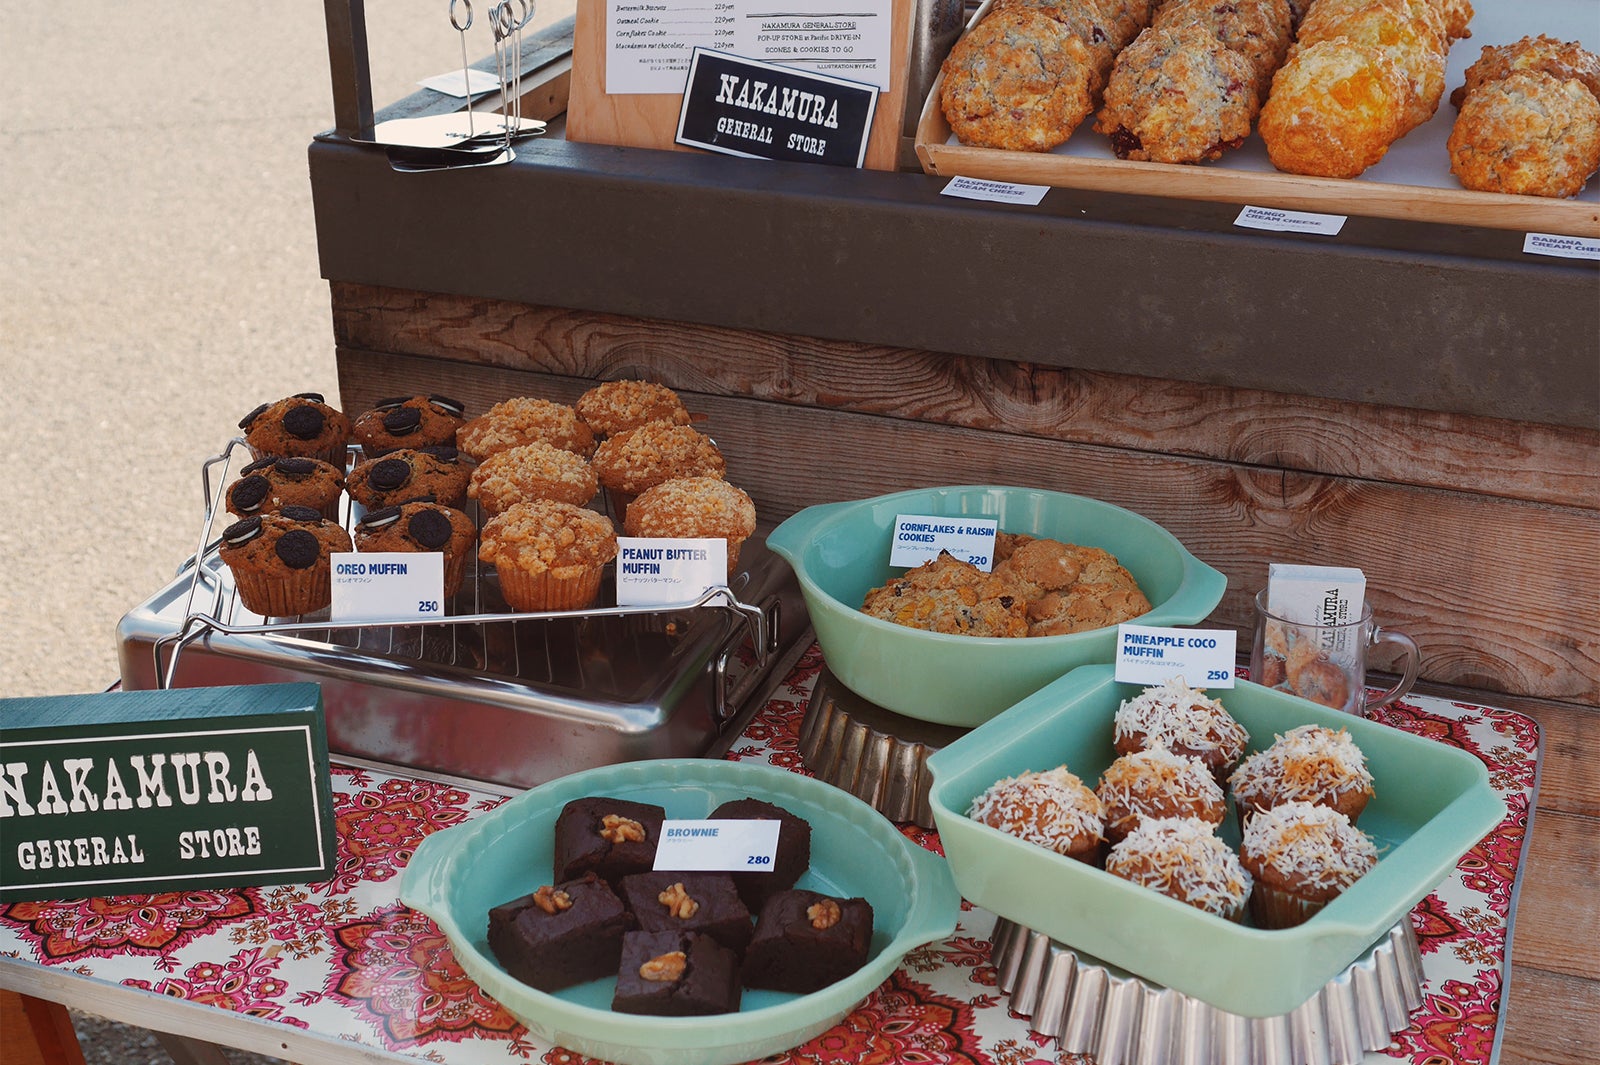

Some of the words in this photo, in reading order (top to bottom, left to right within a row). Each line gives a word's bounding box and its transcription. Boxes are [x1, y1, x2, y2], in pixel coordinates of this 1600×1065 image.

[716, 73, 839, 129] NAKAMURA
[717, 116, 773, 144] GENERAL
[787, 133, 826, 156] STORE
[957, 179, 1015, 190] RASPBERRY
[989, 188, 1026, 196] CHEESE
[1246, 214, 1280, 222] CREAM
[1248, 209, 1286, 218] MANGO
[1532, 236, 1582, 246] BANANA
[1532, 242, 1572, 250] CREAM
[900, 522, 955, 534] CORNFLAKES
[957, 526, 964, 534] &
[966, 527, 995, 536] RAISIN
[898, 532, 936, 542] COOKIES
[622, 548, 664, 560] PEANUT
[666, 549, 707, 560] BUTTER
[968, 556, 988, 565] 220
[336, 564, 366, 575] OREO
[369, 563, 408, 575] MUFFIN
[622, 562, 660, 574] MUFFIN
[418, 601, 439, 612] 250
[1124, 634, 1184, 648] PINEAPPLE
[1188, 638, 1216, 648] COCO
[1124, 646, 1164, 658] MUFFIN
[1207, 670, 1229, 680] 250
[0, 748, 273, 818] NAKAMURA
[667, 828, 720, 837] BROWNIE
[18, 834, 144, 870] GENERAL
[179, 826, 262, 860] STORE
[747, 856, 770, 864] 280
